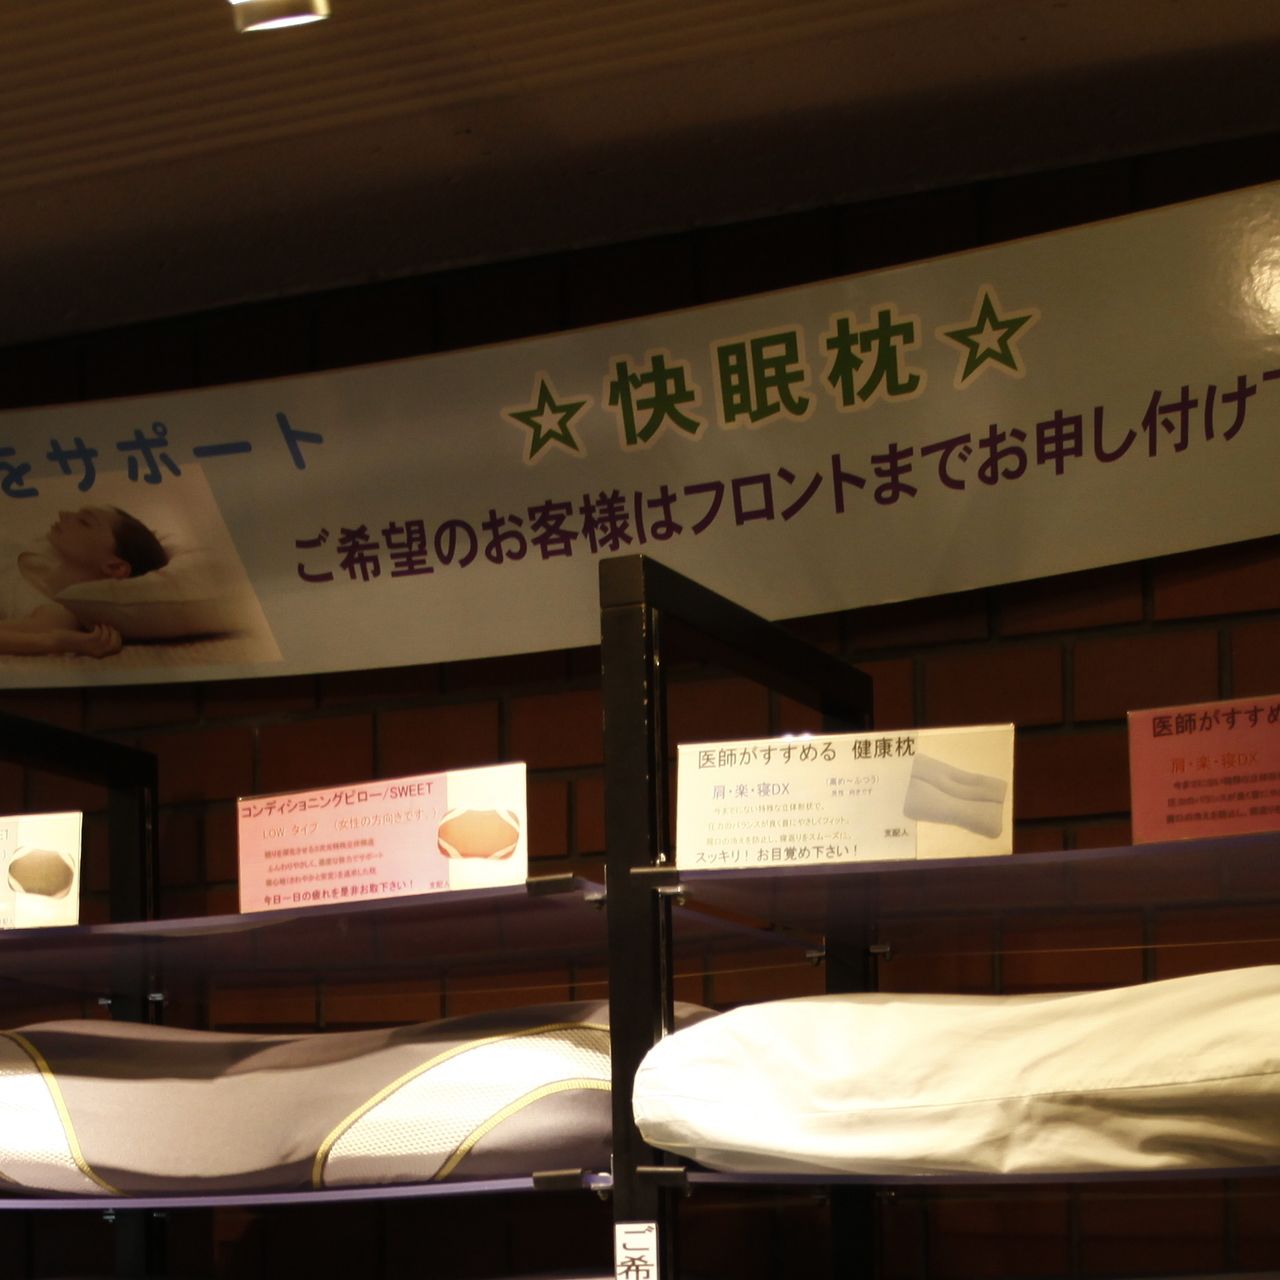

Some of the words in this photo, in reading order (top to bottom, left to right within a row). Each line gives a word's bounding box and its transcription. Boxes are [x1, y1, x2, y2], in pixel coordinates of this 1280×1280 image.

[698, 742, 837, 769] 医師がすすめる
[851, 736, 916, 759] 健康枕
[756, 844, 859, 863] お目覚め下さい！
